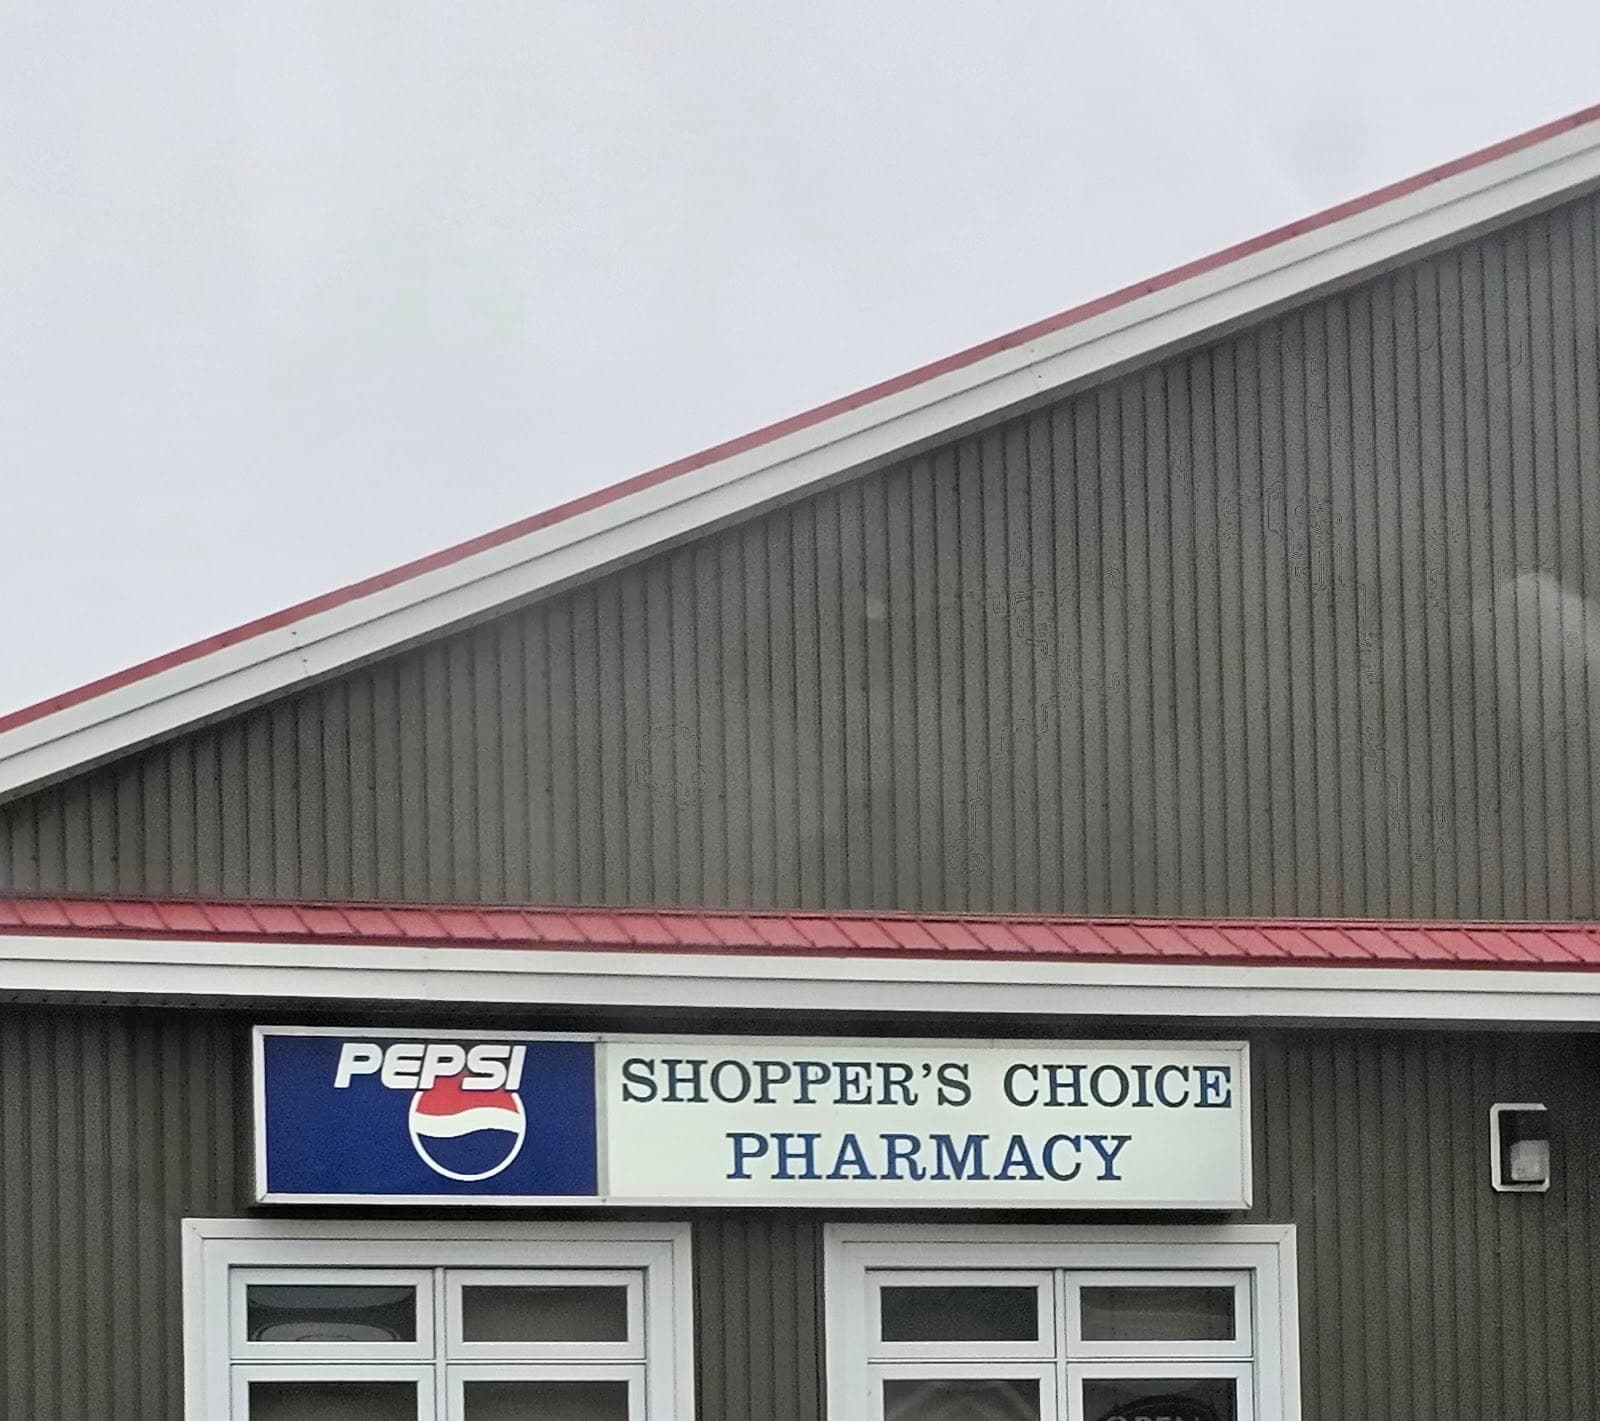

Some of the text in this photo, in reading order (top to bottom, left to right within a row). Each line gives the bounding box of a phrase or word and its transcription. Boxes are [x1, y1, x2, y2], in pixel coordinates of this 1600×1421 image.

[334, 1042, 527, 1091] PEPSI
[621, 1057, 1232, 1109] SHOPPER'S CHOICE
[725, 1132, 1132, 1182] PHARMACY
